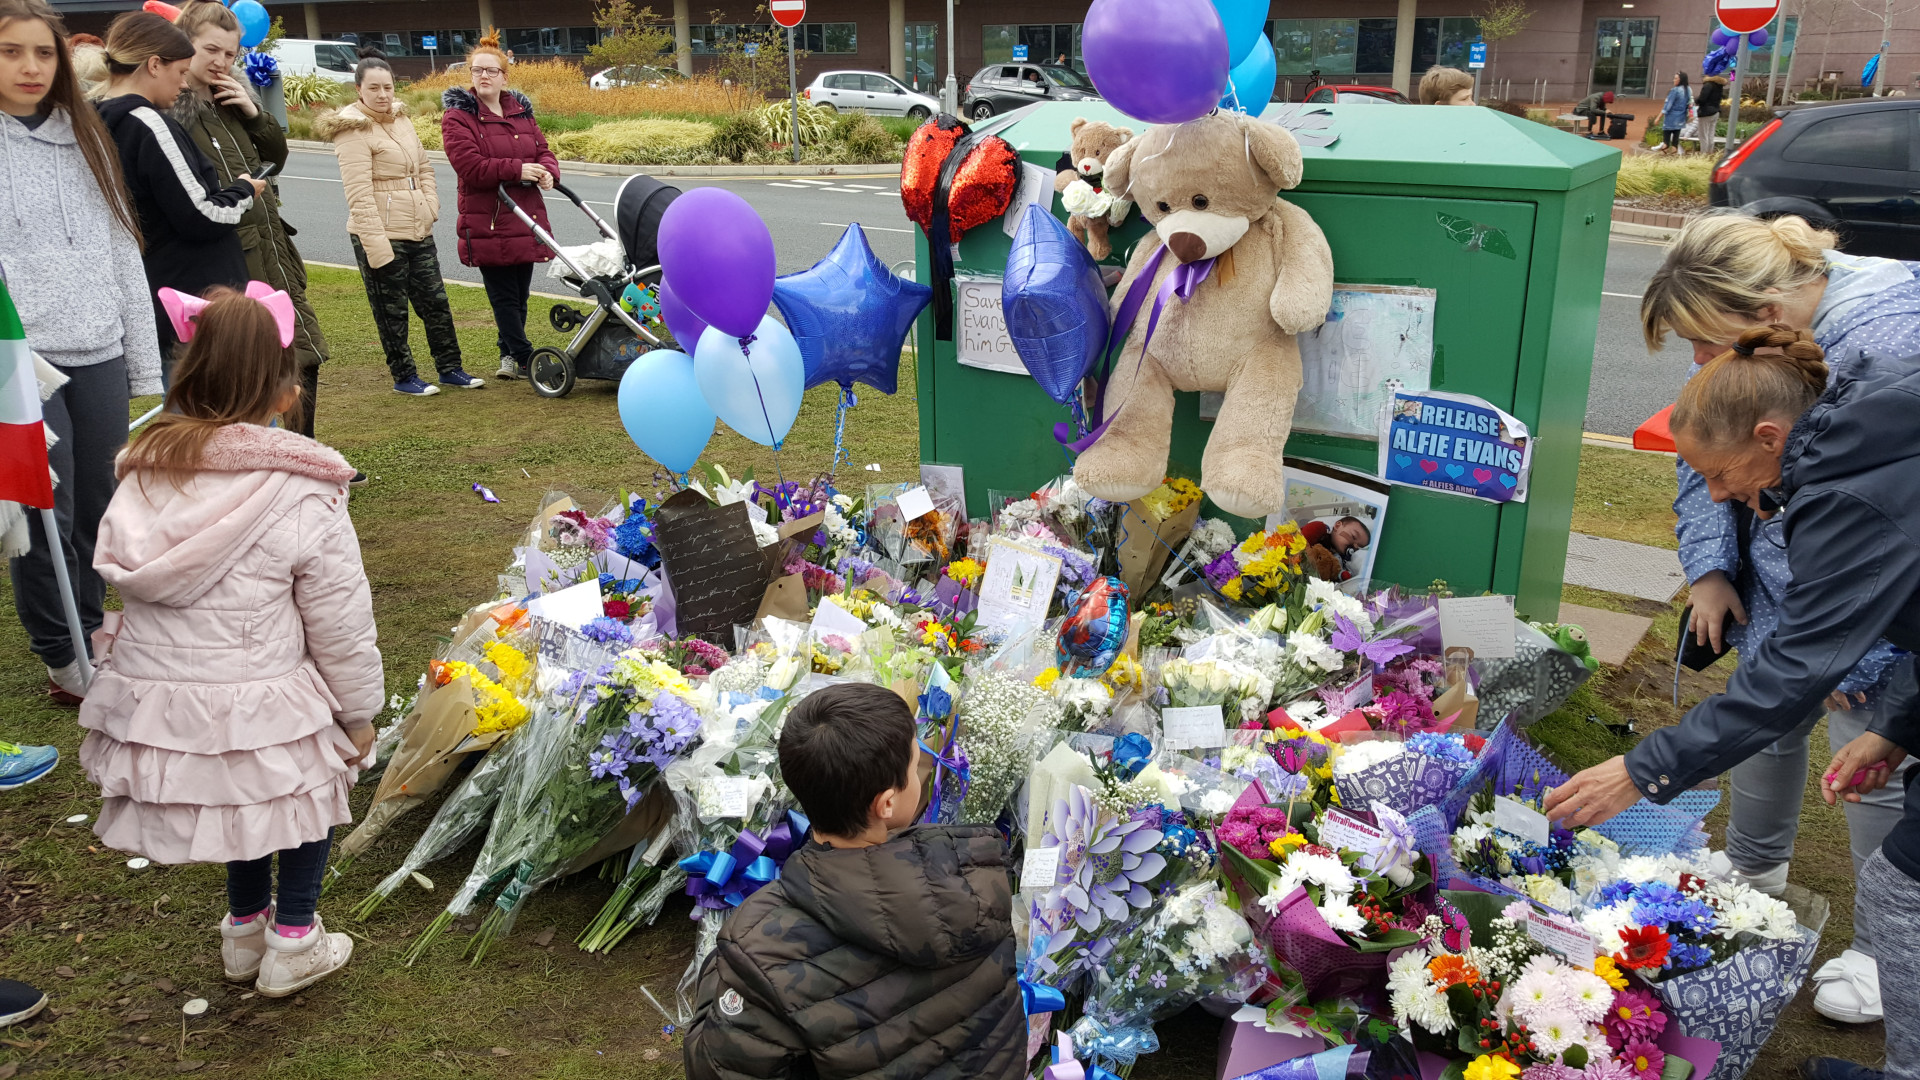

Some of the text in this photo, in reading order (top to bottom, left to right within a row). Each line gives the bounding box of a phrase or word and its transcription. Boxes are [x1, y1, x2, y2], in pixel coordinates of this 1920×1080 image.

[964, 287, 1003, 311] Save
[965, 330, 993, 353] him
[1421, 404, 1499, 437] RELEASE
[1392, 428, 1522, 474] ALFIE EVANS
[1455, 484, 1478, 496] ARMY
